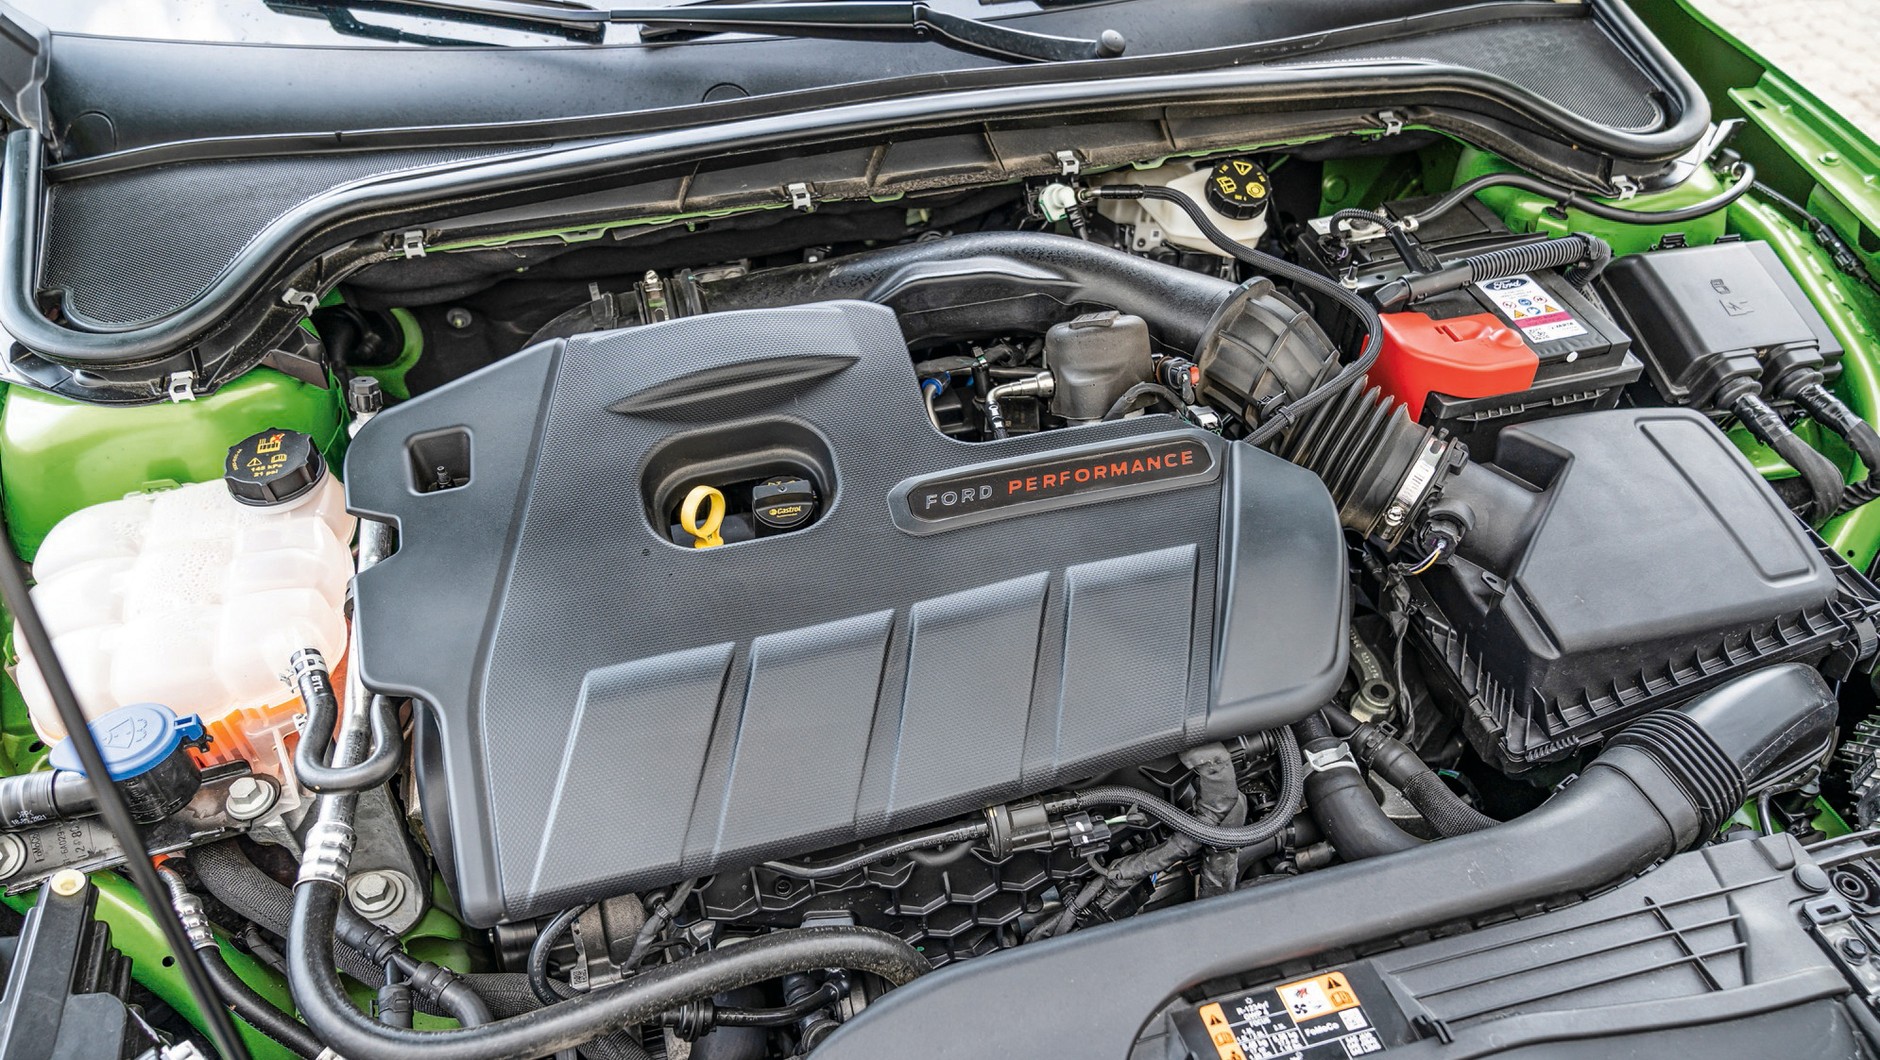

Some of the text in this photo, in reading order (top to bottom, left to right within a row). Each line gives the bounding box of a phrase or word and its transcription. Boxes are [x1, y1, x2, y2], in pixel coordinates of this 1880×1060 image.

[924, 450, 1195, 510] FORD PERFORMANCE
[777, 505, 802, 515] Castrol
[1304, 1022, 1340, 1037] FoMoCo
